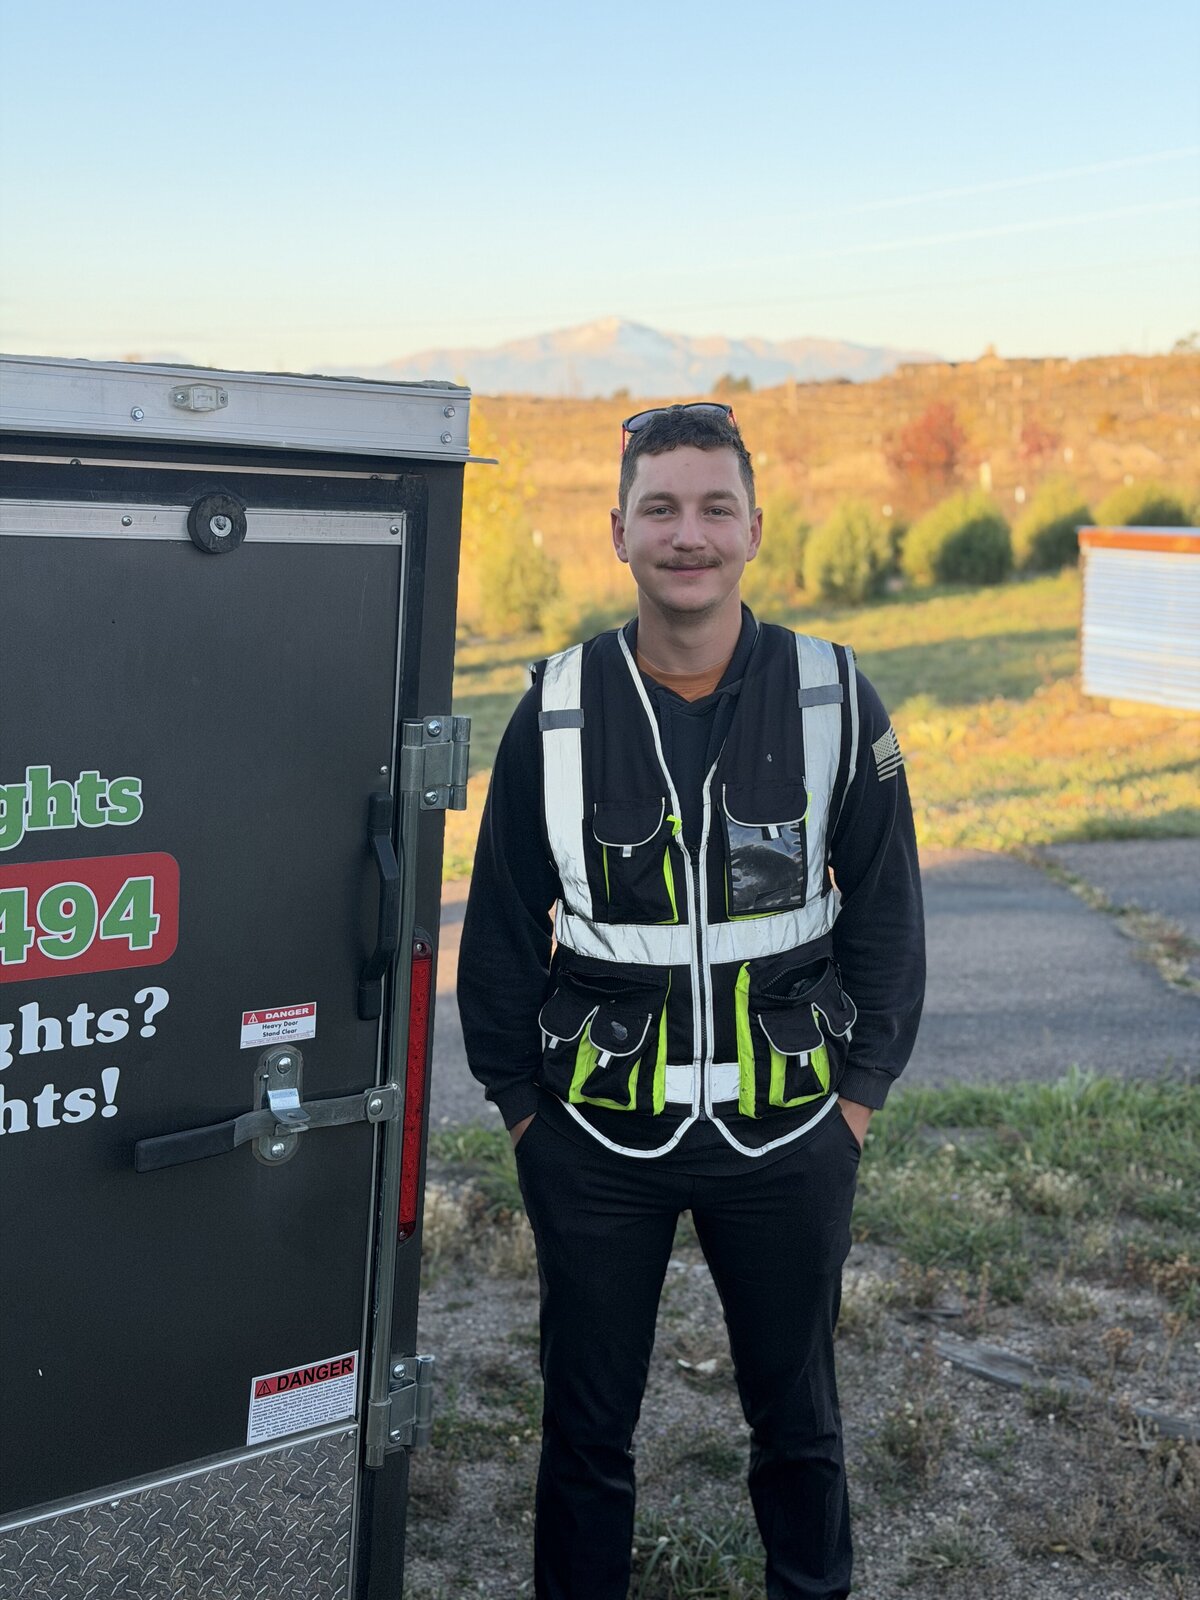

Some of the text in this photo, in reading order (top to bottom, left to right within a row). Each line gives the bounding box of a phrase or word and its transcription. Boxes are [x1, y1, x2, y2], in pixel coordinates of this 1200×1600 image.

[0, 875, 160, 966] 494
[265, 1007, 309, 1020] DANGER
[262, 1022, 282, 1030] Heavy
[262, 1030, 280, 1038] Stand
[277, 1357, 353, 1392] DANGER
